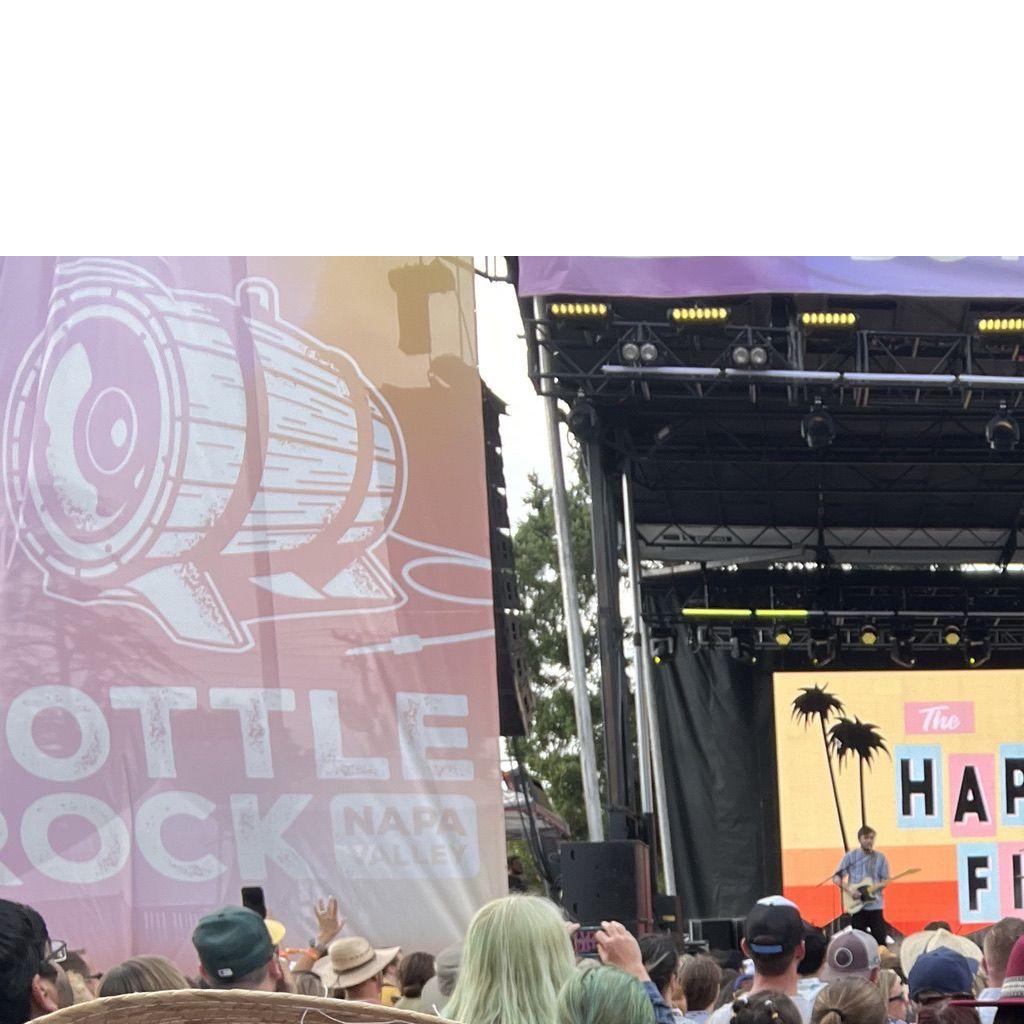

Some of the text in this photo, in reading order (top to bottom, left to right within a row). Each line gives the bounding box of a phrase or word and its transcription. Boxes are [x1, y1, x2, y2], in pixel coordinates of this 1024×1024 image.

[918, 704, 962, 732] The
[343, 805, 466, 837] NAPA
[0, 790, 313, 886] OCK
[350, 842, 468, 869] VALLEY
